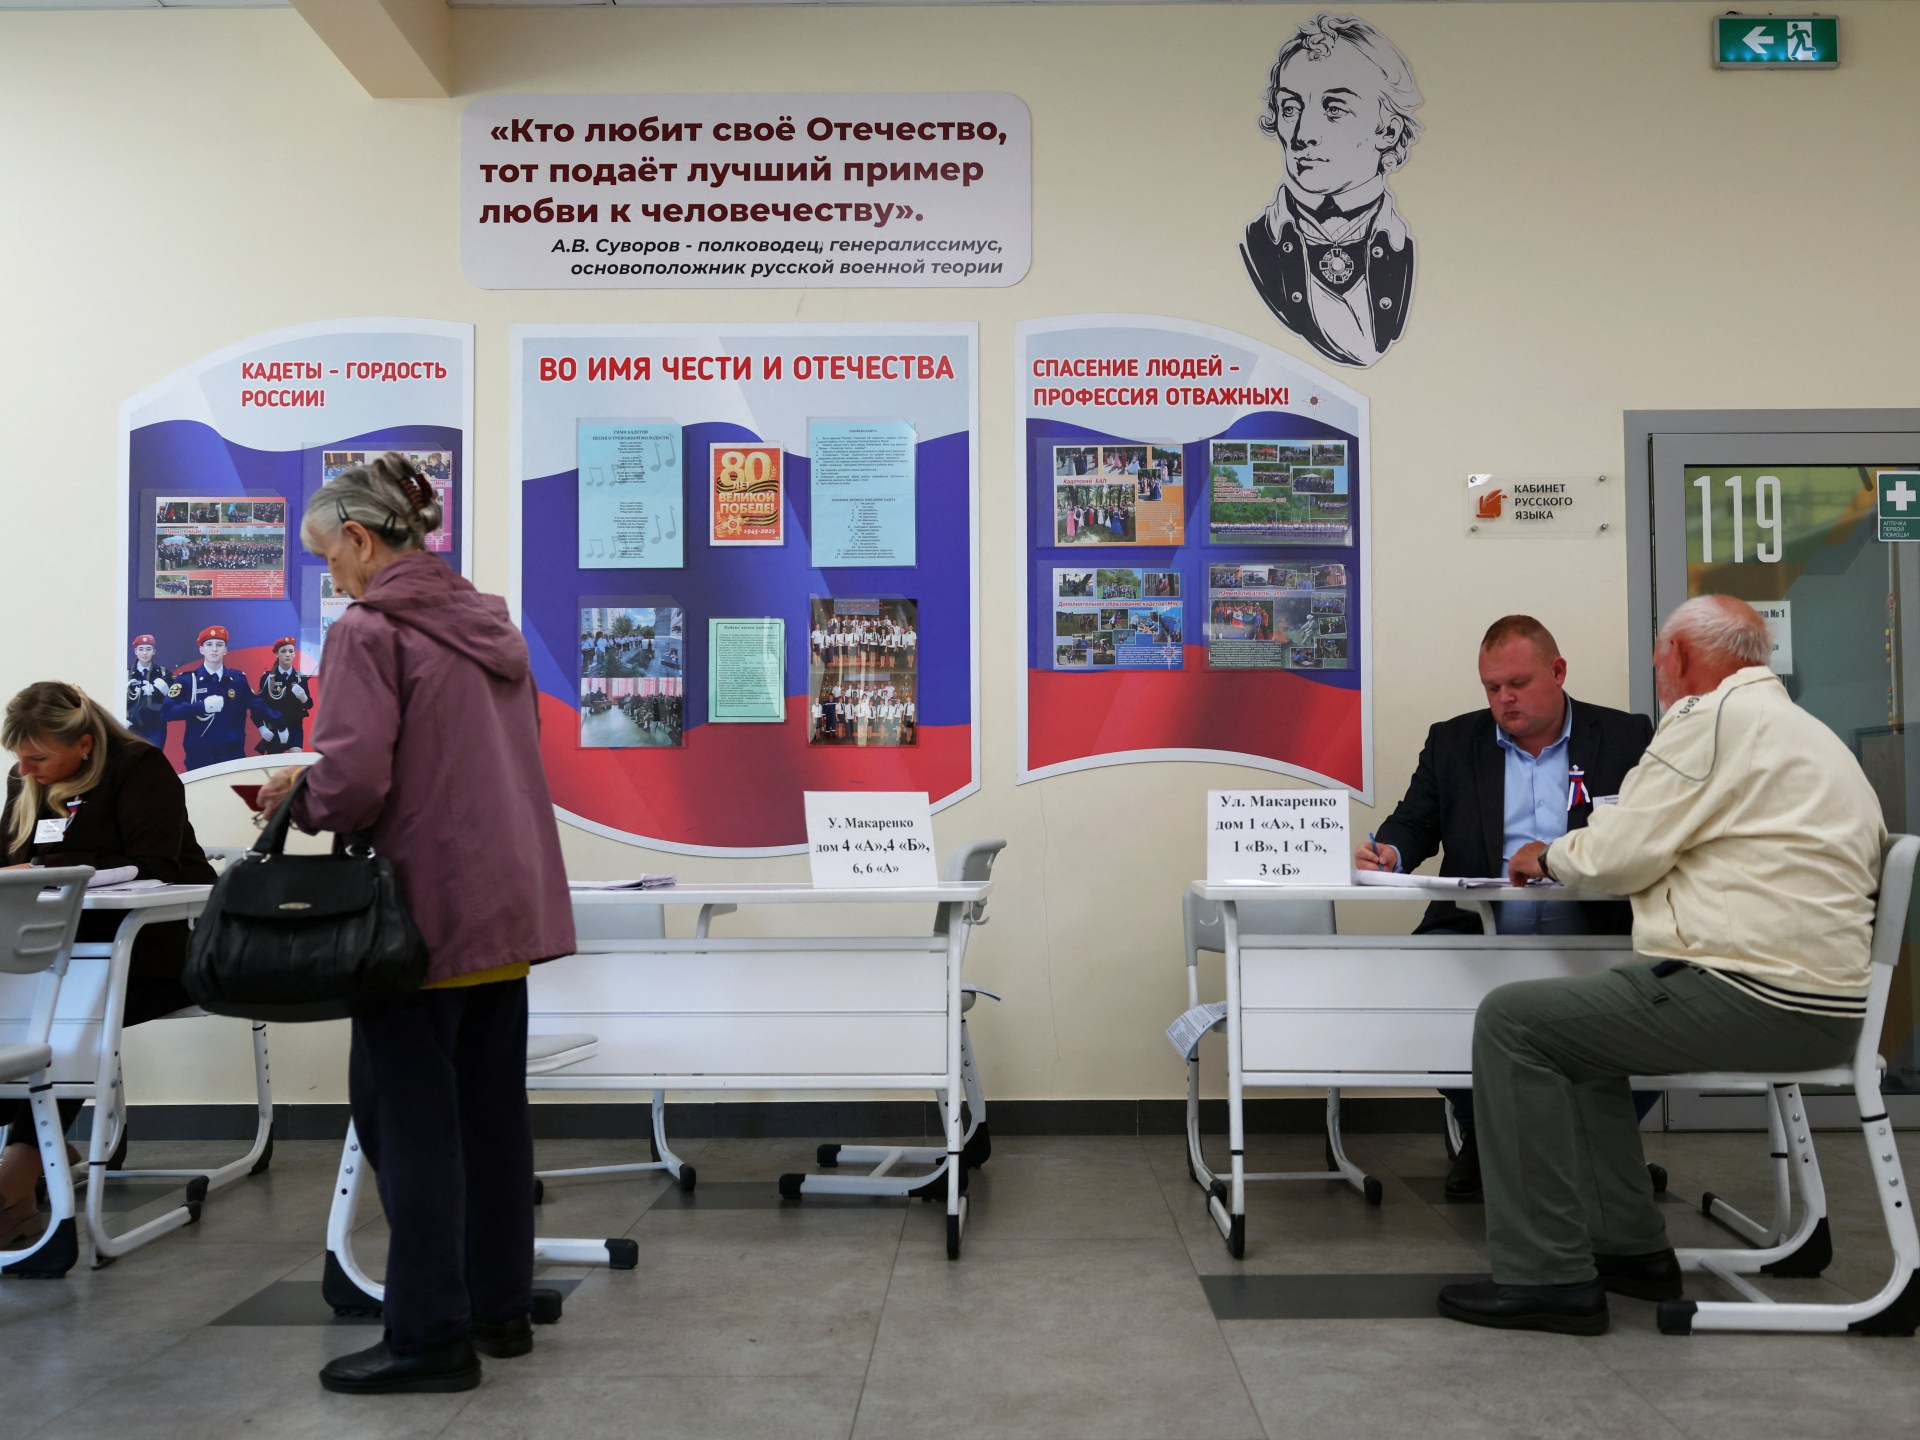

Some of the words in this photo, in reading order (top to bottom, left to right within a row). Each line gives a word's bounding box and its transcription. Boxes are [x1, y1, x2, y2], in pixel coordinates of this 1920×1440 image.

[491, 118, 575, 143] «Кто
[585, 116, 703, 143] любит
[713, 115, 796, 142] своё
[806, 117, 1007, 146] Отечество,
[480, 164, 539, 183] тот
[550, 157, 678, 186] подаёт
[687, 156, 832, 187] лучший
[844, 162, 984, 187] пример
[480, 197, 598, 224] любви
[611, 204, 632, 223] к
[641, 203, 924, 228] человечеству».
[551, 239, 590, 253] А.В.
[595, 239, 681, 256] Суворов
[697, 240, 824, 256] полководец,
[830, 240, 1003, 255] генералиссимус,
[570, 261, 747, 277] основоположник
[750, 259, 835, 278] русской
[839, 259, 926, 275] военной
[931, 261, 1004, 277] теории
[241, 362, 323, 382] КАДЕТЫ
[346, 361, 448, 382] ГОРДОСТЬ
[540, 357, 577, 382] ВО
[588, 357, 651, 382] ИМЯ
[662, 356, 751, 381] ЧЕСТИ
[763, 356, 782, 380] И
[793, 355, 955, 381] ОТЕЧЕСТВА
[1033, 358, 1139, 377] СПАСЕНИЕ
[1146, 355, 1223, 380] ЛЮДЕЙ
[241, 389, 325, 407] РОССИИ!
[1033, 387, 1159, 406] ПРОФЕССИЯ
[1165, 387, 1290, 406] ОТВАЖНЫХ!
[720, 451, 772, 487] 80
[733, 482, 751, 490] ЛЕТ
[1514, 484, 1566, 494] КАБИНЕТ
[719, 490, 775, 502] ВЕЛИКОЙ
[1514, 496, 1573, 507] РУССКОГО
[720, 503, 775, 514] ПОБЕДЕ!
[1515, 510, 1554, 520] ЯЗЫКА
[1693, 475, 1783, 563] 119
[1220, 795, 1246, 808] Ул.
[1250, 795, 1337, 811] Макаренко
[828, 817, 842, 829] У.
[845, 817, 914, 831] Макаренко
[1215, 821, 1244, 831] дом
[1249, 817, 1256, 830] 1
[1261, 817, 1295, 831] «А»,
[1300, 817, 1306, 830] 1
[1311, 817, 1344, 831] «Б»,
[816, 844, 839, 853] дом
[842, 839, 851, 852] 4
[898, 838, 930, 852] «Б»,
[1233, 840, 1240, 853] 1
[1245, 840, 1278, 854] «В»,
[1283, 840, 1289, 853] 1
[1294, 840, 1327, 854] «Г»,
[852, 863, 864, 875] 6,
[866, 863, 873, 874] 6
[876, 863, 900, 874] «А»
[1259, 863, 1268, 876] 3
[1272, 863, 1301, 876] «Б»
